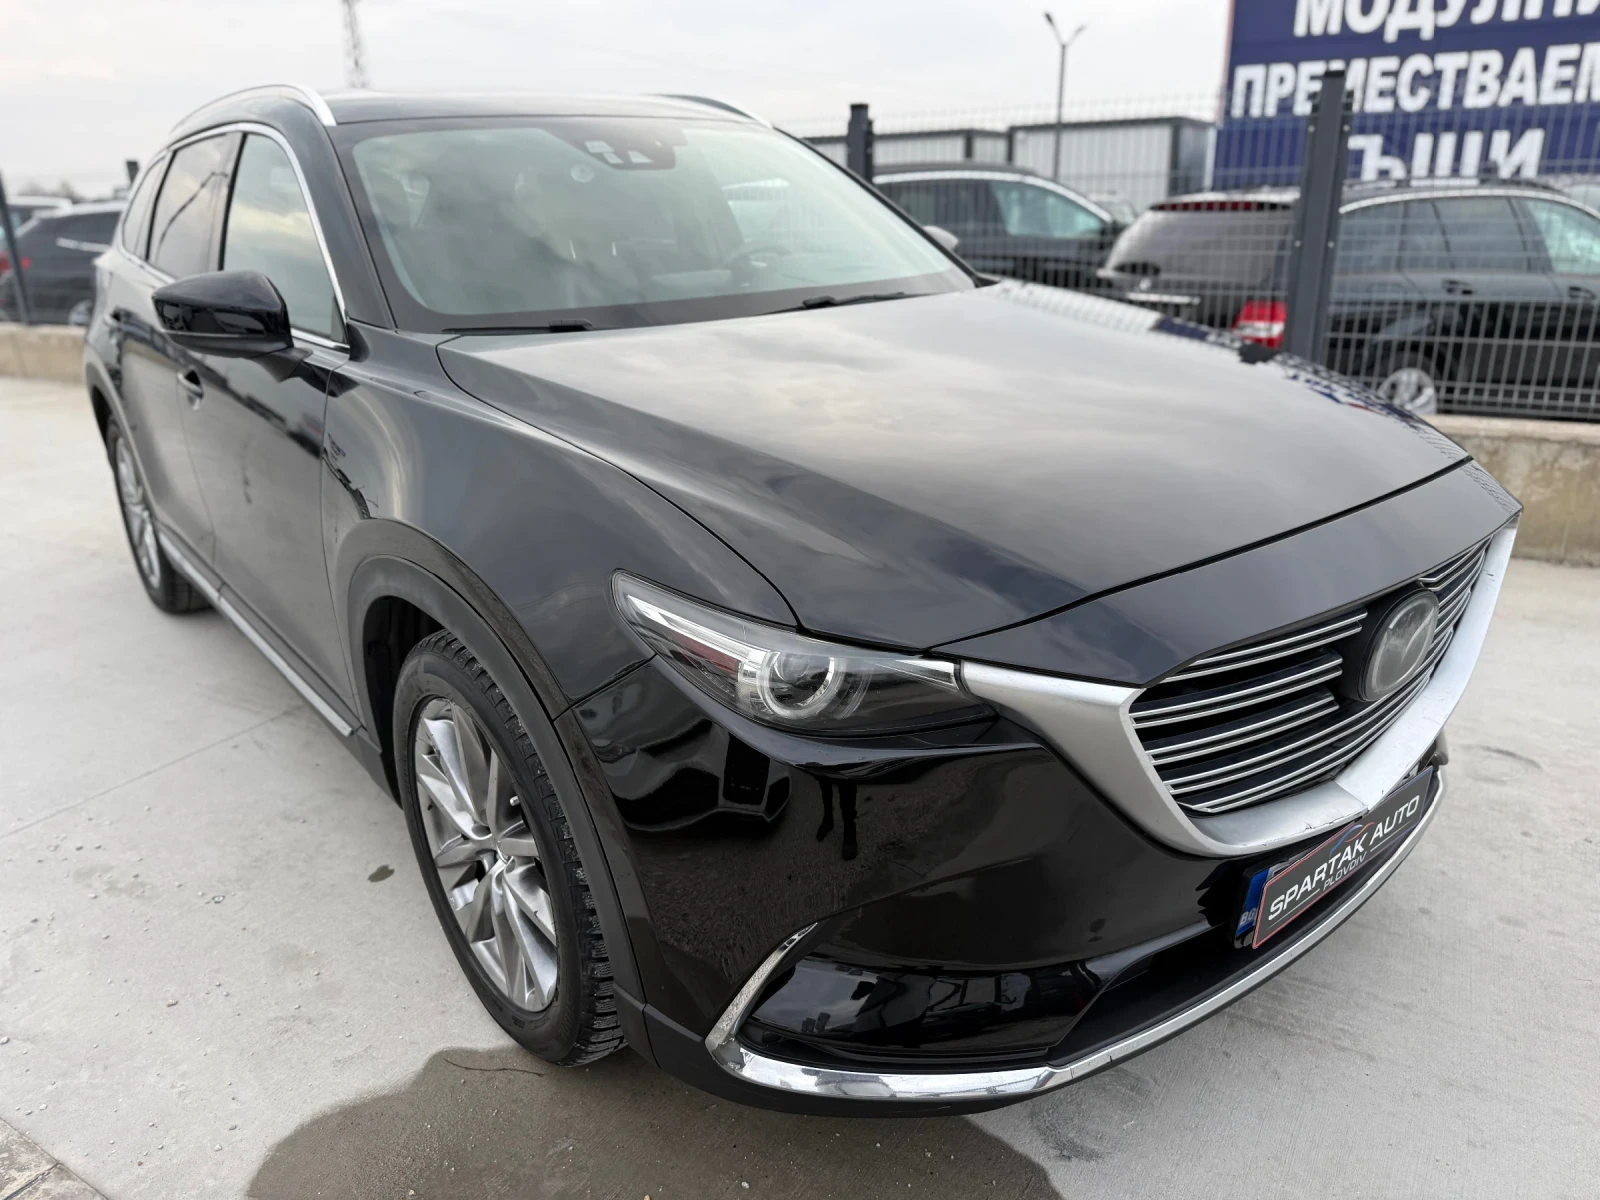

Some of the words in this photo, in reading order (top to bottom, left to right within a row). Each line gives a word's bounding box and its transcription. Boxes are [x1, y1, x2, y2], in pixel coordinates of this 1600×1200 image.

[1268, 832, 1368, 921] SPARTAK
[1369, 794, 1420, 846] AUTO
[1323, 851, 1367, 890] PLOVDIV
